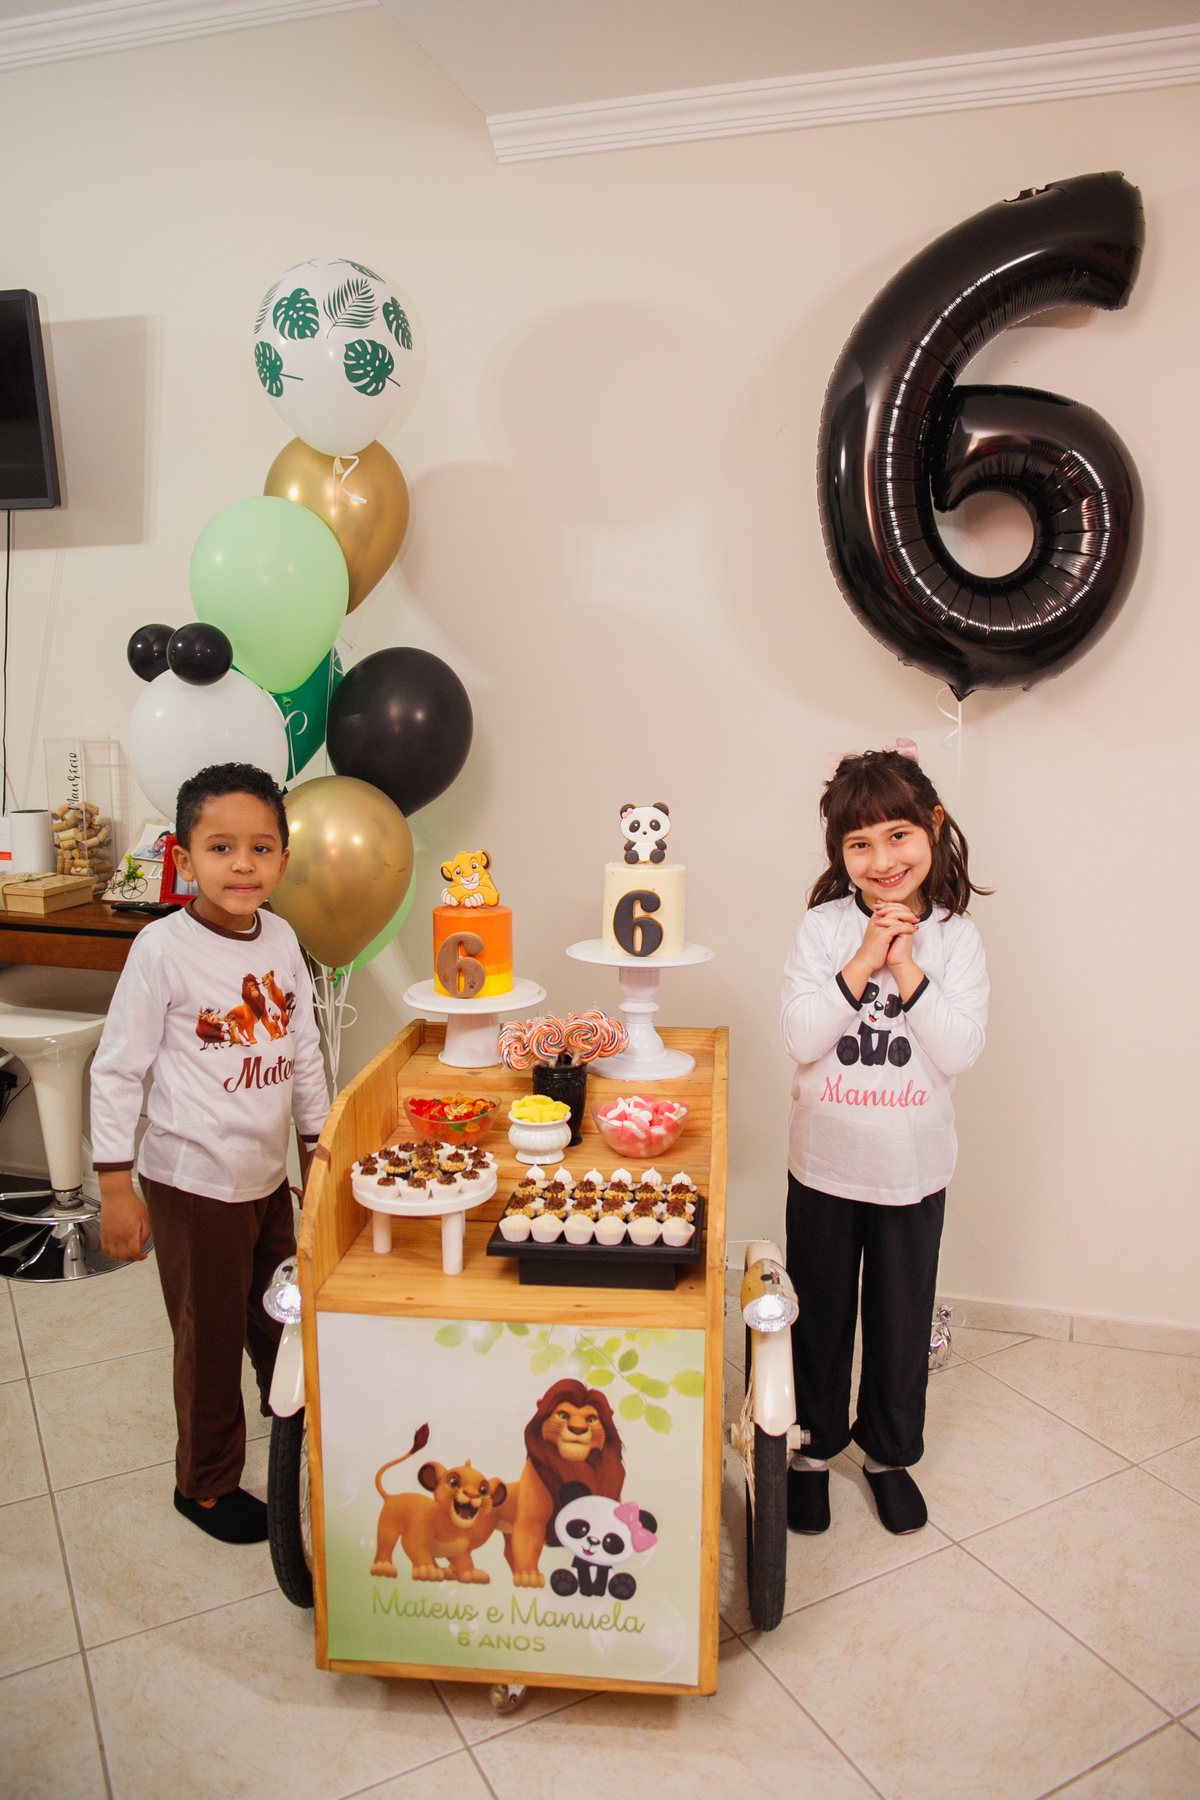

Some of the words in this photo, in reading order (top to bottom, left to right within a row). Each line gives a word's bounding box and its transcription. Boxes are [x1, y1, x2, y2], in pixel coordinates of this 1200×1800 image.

[816, 171, 1146, 695] 6
[613, 889, 664, 957] 6
[437, 931, 487, 999] 6
[223, 1055, 295, 1094] Mateu
[372, 1584, 479, 1622] Mateus
[486, 1605, 504, 1623] e
[510, 1594, 645, 1634] Manuela
[457, 1631, 471, 1647] 6
[478, 1633, 546, 1653] ANOS
